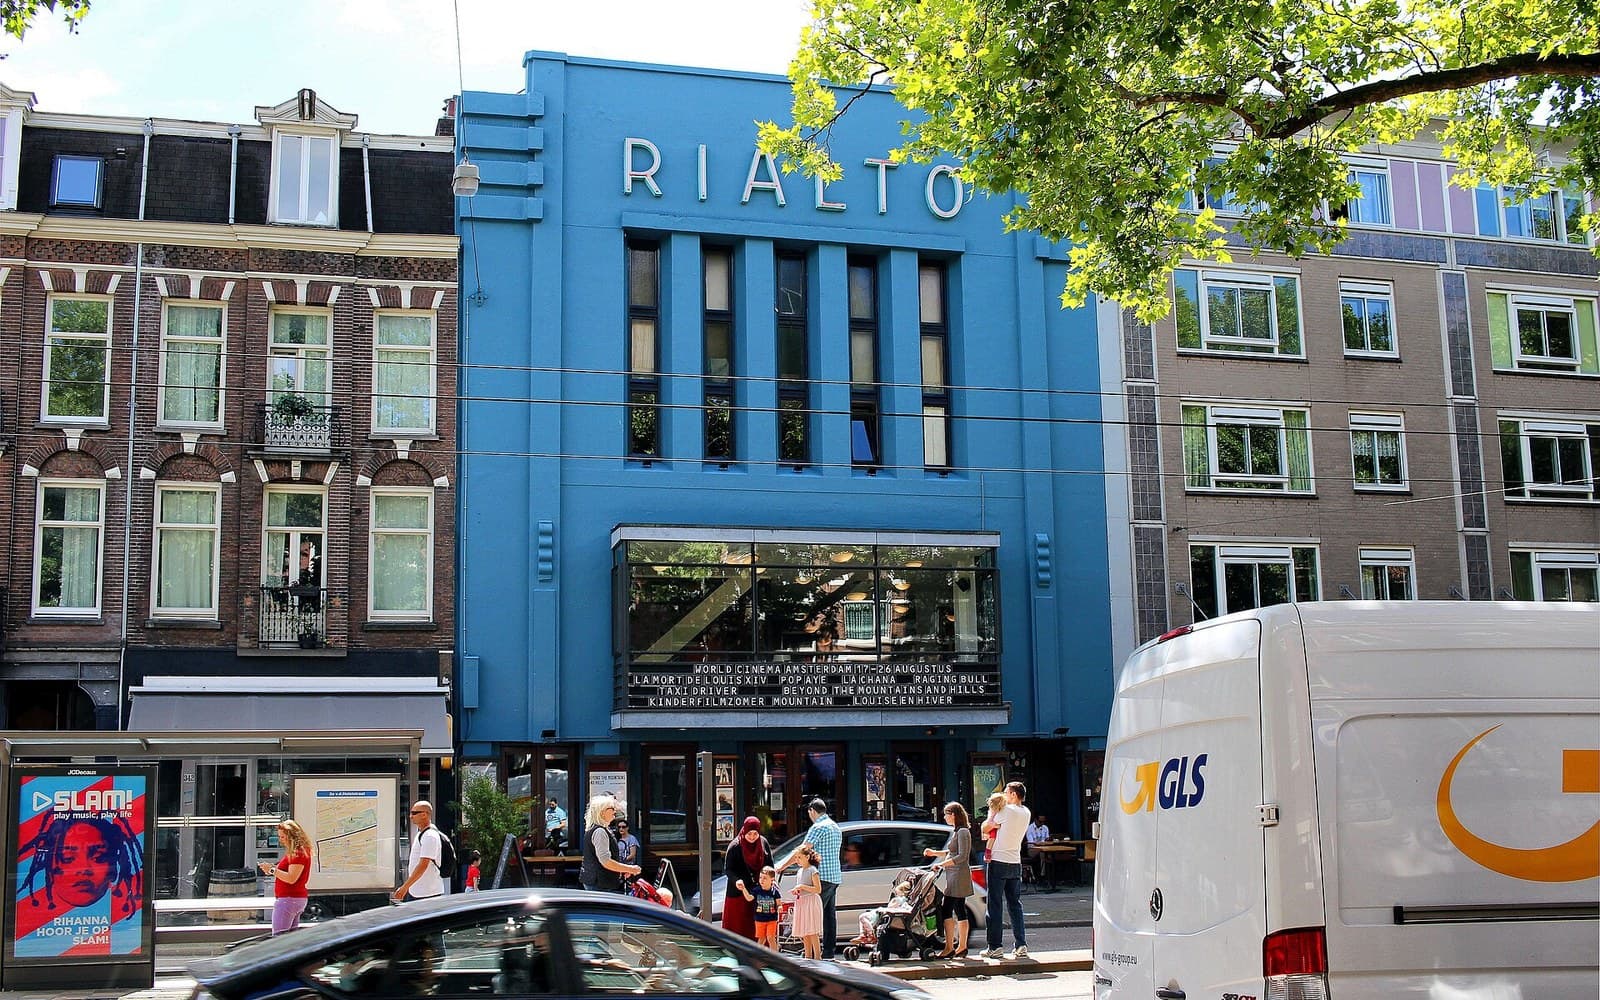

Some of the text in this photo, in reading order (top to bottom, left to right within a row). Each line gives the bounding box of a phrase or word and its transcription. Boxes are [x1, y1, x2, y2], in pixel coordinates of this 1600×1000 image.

[623, 137, 964, 220] RIALTO
[695, 664, 952, 674] WORLD CINEMA AMSTERDAM 17-26 AUGUSTUS
[687, 675, 701, 684] DE
[705, 675, 742, 684] LOUIS
[745, 675, 767, 684] XIV
[781, 675, 827, 684] POPAYE
[915, 675, 988, 684] RAGING BULL
[659, 687, 737, 695] TAXI DRIVER
[783, 685, 985, 695] BEYOND THE MOUNTAINS AND HILLS
[649, 697, 765, 706] KINDERFILMZOMER
[773, 697, 833, 706] MOUNTAIN
[854, 696, 952, 705] LOUISE EN HIVER
[1158, 753, 1208, 810] GLS
[54, 789, 133, 812] SLAM!
[53, 810, 132, 821] play music, play life
[53, 915, 109, 926] RIHANNA
[36, 926, 109, 937] HOOR JE OP
[72, 935, 110, 945] SLAM!
